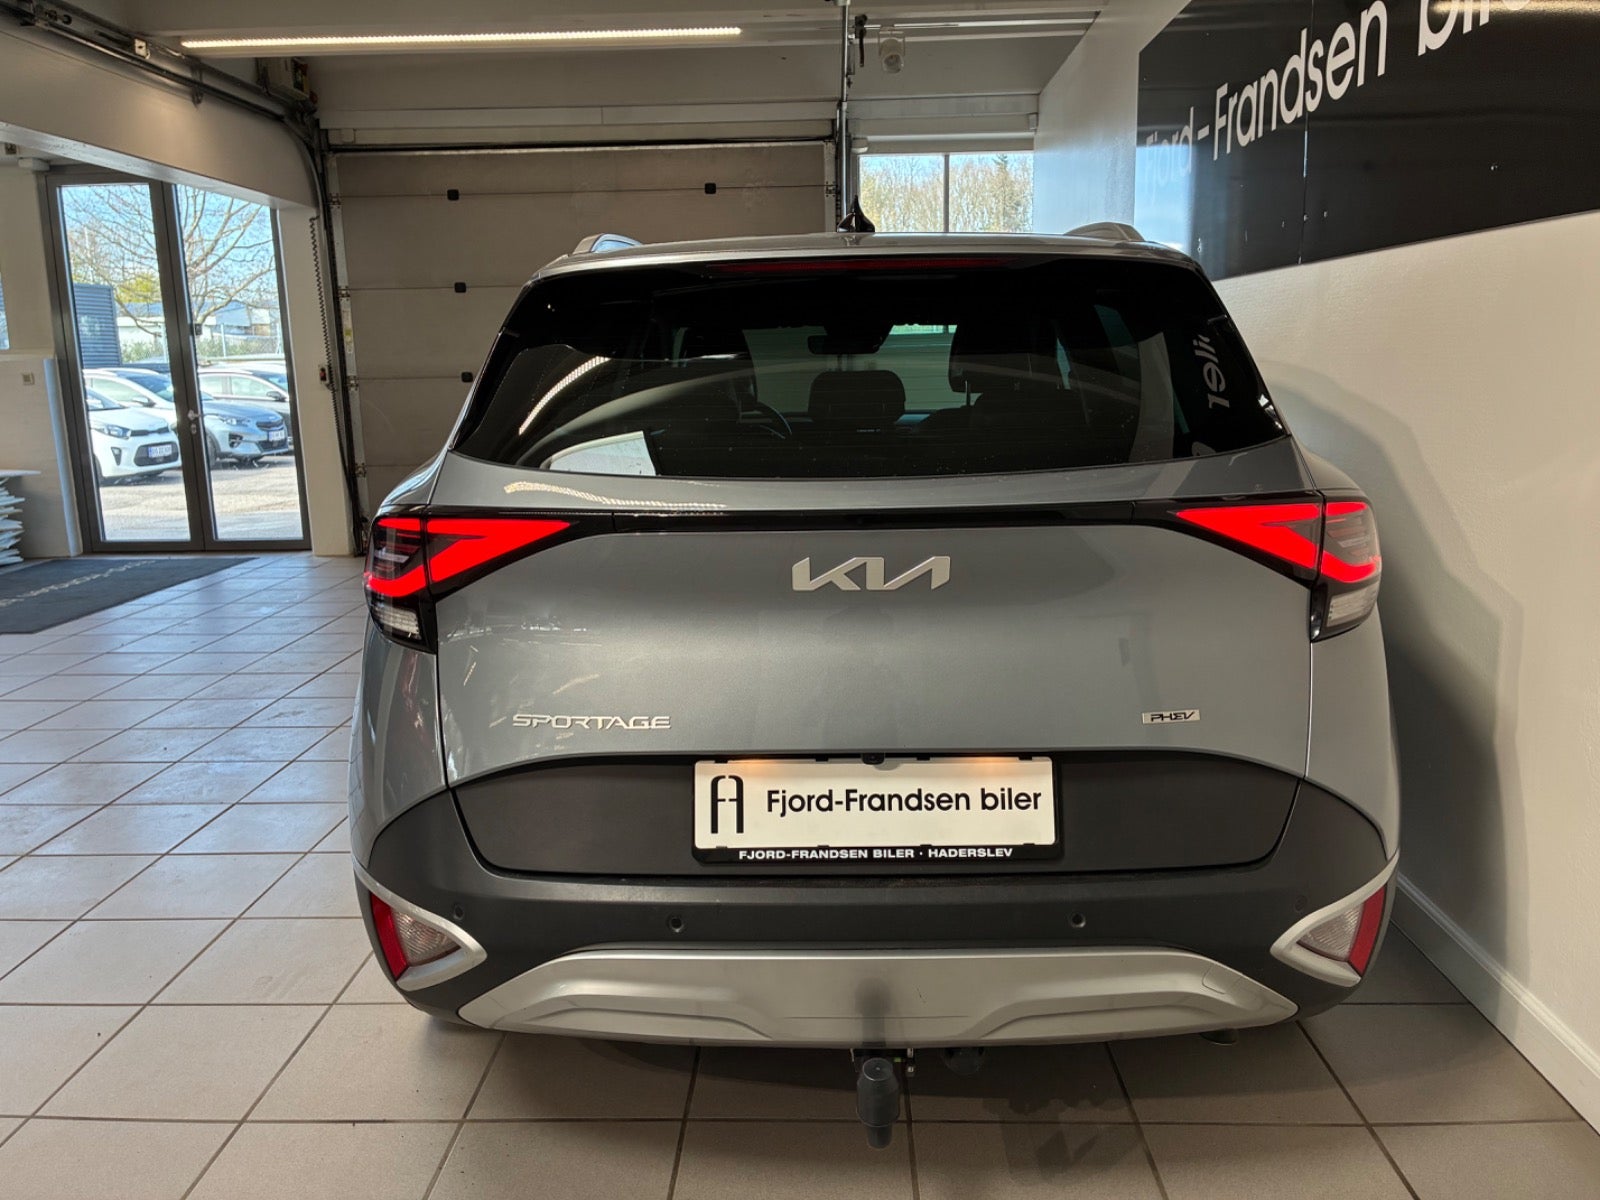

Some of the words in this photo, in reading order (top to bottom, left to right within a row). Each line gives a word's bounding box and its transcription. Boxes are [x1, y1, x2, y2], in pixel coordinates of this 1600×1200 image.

[792, 556, 950, 591] KIA
[512, 714, 671, 729] SPORTAGE
[1150, 711, 1195, 722] PHEV
[767, 788, 971, 817] Fjord-Frandsen
[980, 787, 1042, 811] biler
[738, 849, 868, 860] FJORD-FRANDSEN
[872, 848, 915, 859] BILER
[928, 847, 1013, 858] HADERSLEV
